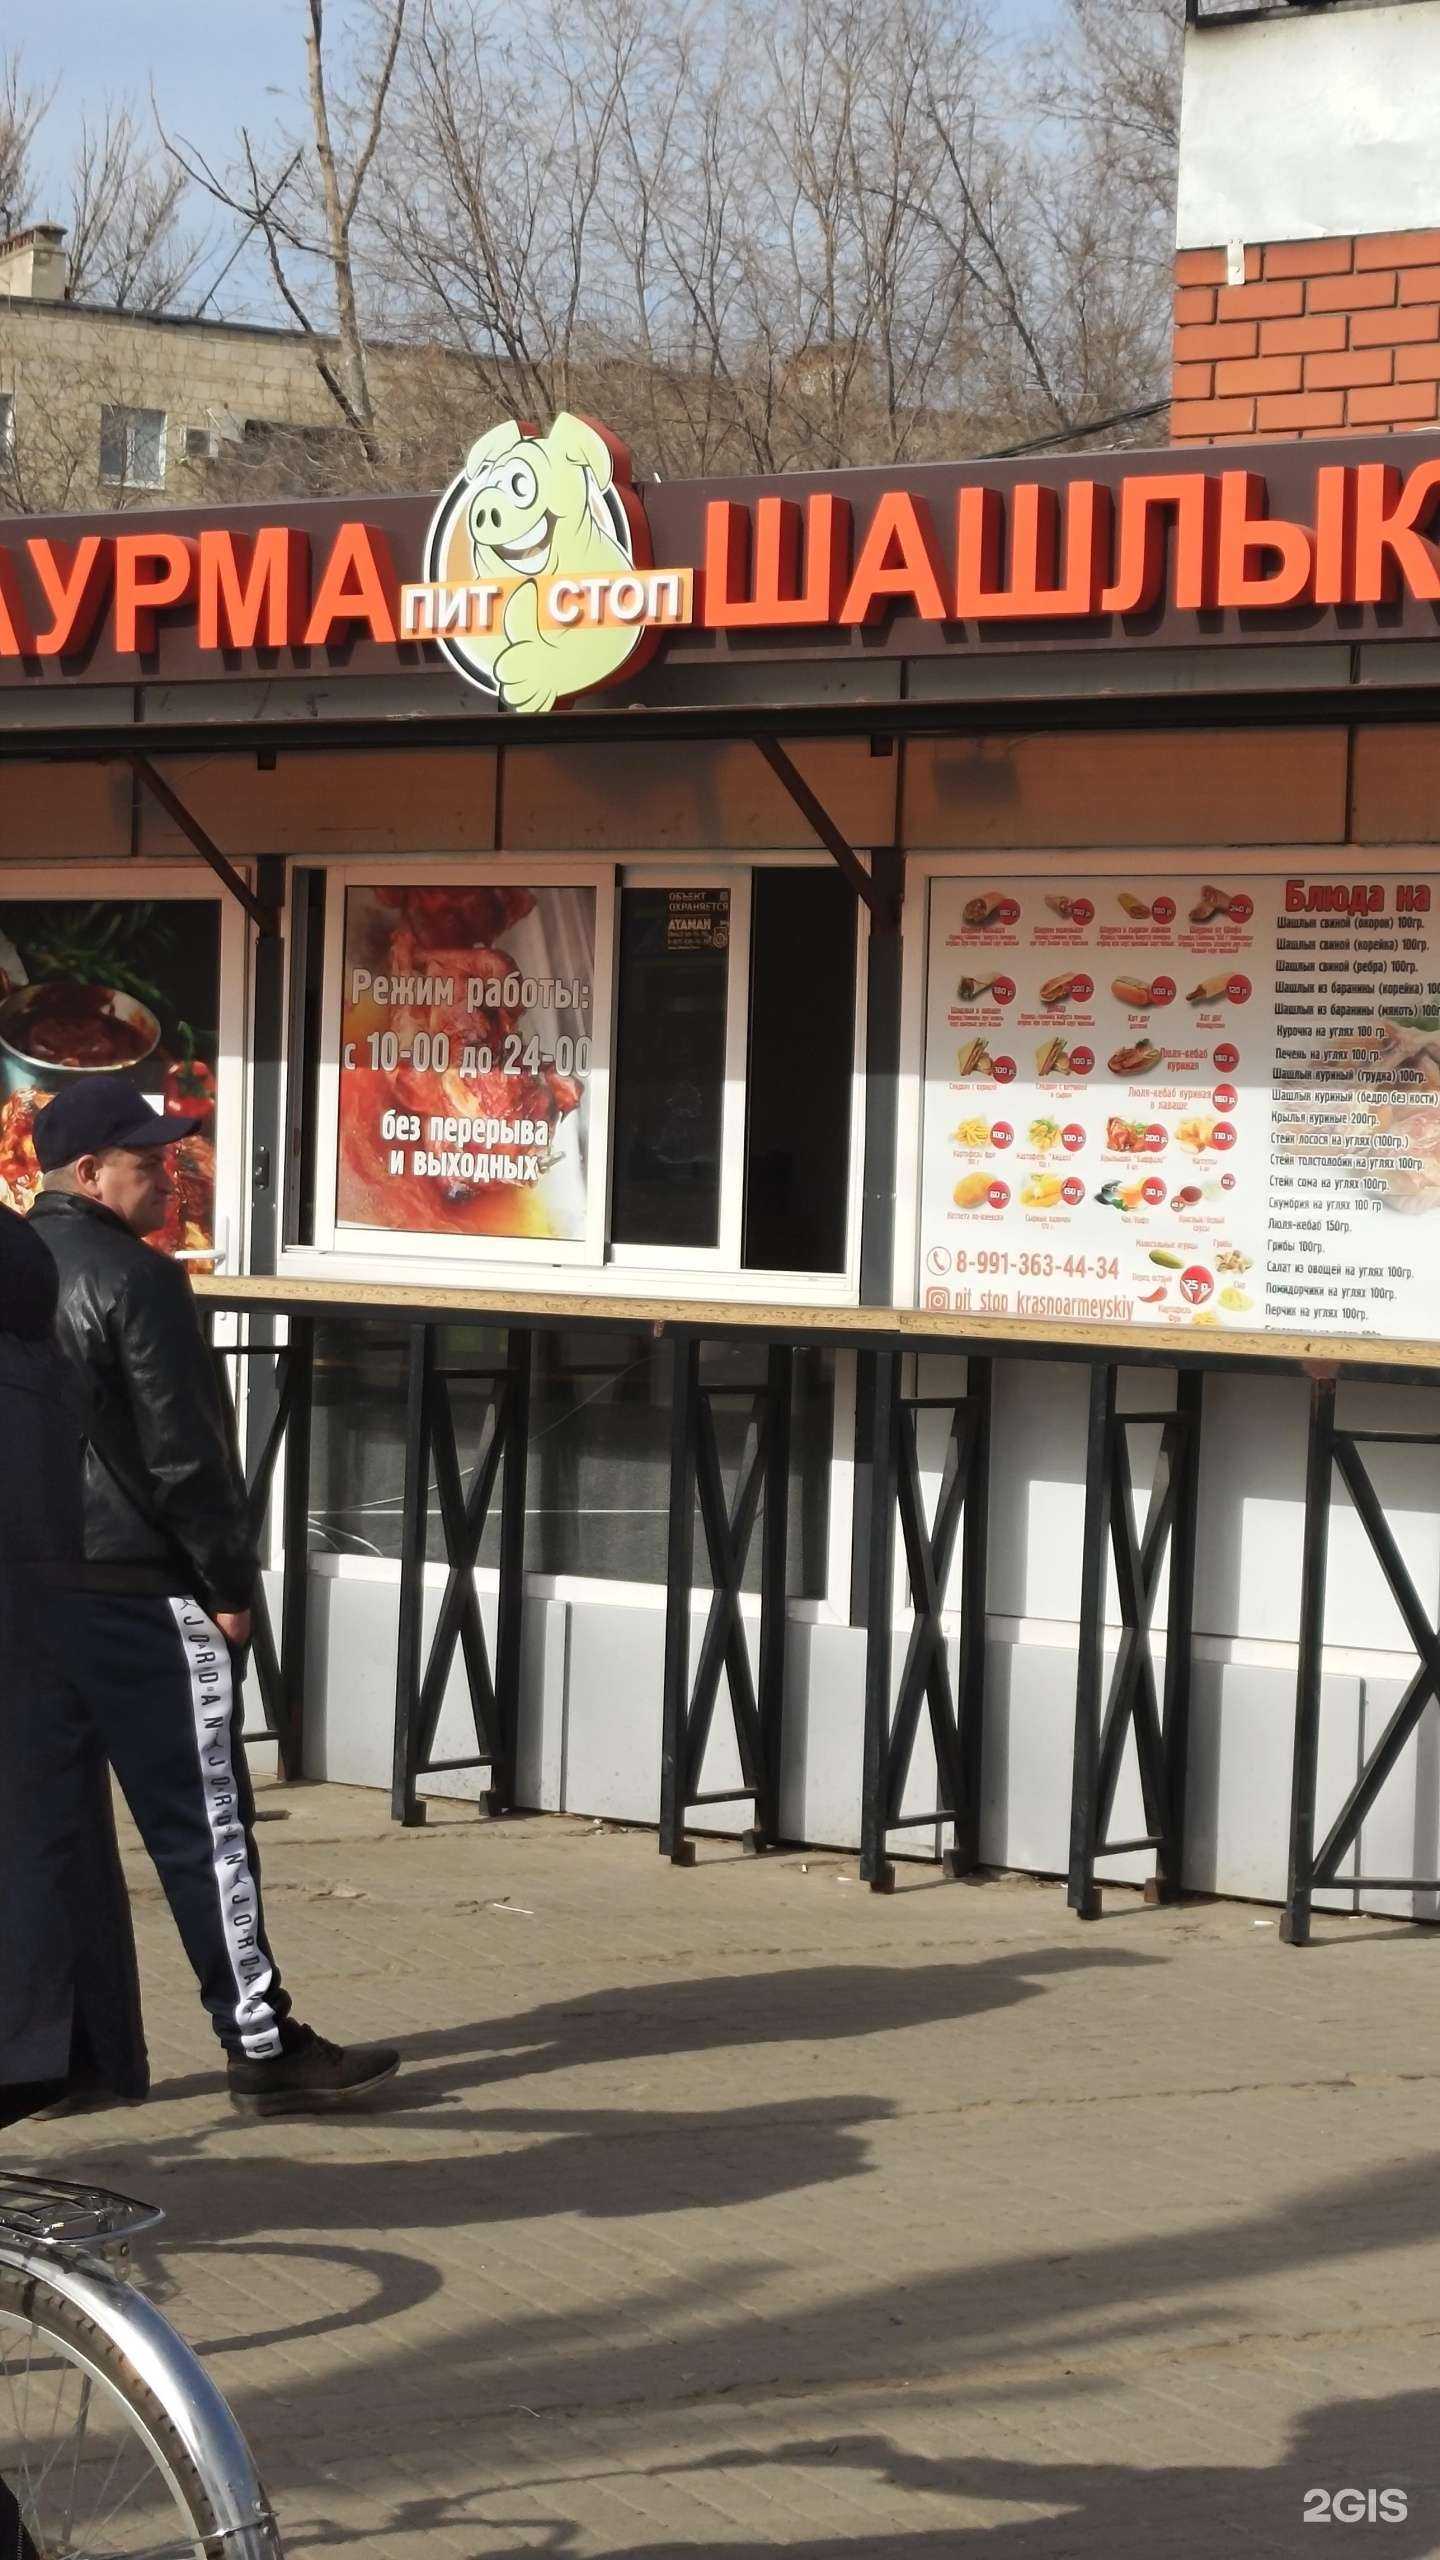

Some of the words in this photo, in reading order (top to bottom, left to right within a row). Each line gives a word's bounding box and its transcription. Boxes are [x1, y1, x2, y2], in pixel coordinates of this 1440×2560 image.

[705, 459, 1440, 628] ШАШЛЫК
[405, 586, 501, 632] ПИТ
[550, 575, 681, 624] СТОП
[1285, 880, 1385, 916] Блюда
[1396, 884, 1431, 912] на
[1277, 917, 1316, 928] Шашлык
[1276, 938, 1316, 950] Шашлык
[1276, 960, 1315, 972] Шашлык
[351, 969, 454, 1006] Режим
[467, 971, 590, 1013] работы:
[1275, 981, 1314, 993] Шашлык
[1275, 1003, 1313, 1015] Шашлык
[1277, 1025, 1312, 1040] Курочка
[1316, 1027, 1326, 1037] на
[1329, 1027, 1353, 1040] углях
[344, 1043, 356, 1070] с
[367, 1031, 450, 1073] 10-00
[459, 1046, 492, 1079] до
[503, 1034, 592, 1077] 24-00
[1276, 1048, 1306, 1060] Печень
[1310, 1051, 1320, 1060] на
[1324, 1050, 1348, 1063] углях
[1352, 1049, 1365, 1060] 100
[1273, 1068, 1312, 1080] Шашлык
[1357, 1070, 1395, 1083] (грудка)
[1400, 1070, 1426, 1083] 100гр.
[1272, 1089, 1311, 1101] Шашлык
[1357, 1092, 1387, 1104] (бедро
[1391, 1091, 1405, 1103] без
[1410, 1094, 1438, 1106] кости)
[1272, 1112, 1305, 1124] Крылья
[1309, 1114, 1347, 1127] куриные
[1351, 1113, 1379, 1127] 200гр.
[382, 1110, 420, 1141] без
[430, 1116, 549, 1149] перерыва
[1271, 1133, 1294, 1144] Стейк
[1298, 1135, 1329, 1144] лосося
[1332, 1135, 1341, 1145] на
[1345, 1136, 1369, 1147] углях
[1373, 1136, 1409, 1148] (100гр.)
[390, 1150, 404, 1175] и
[413, 1152, 538, 1182] выходных
[1270, 1154, 1294, 1165] Стейк
[1356, 1158, 1366, 1167] на
[1370, 1158, 1394, 1170] углях
[1269, 1175, 1293, 1187] Стейк
[1297, 1178, 1317, 1187] сома
[1321, 1178, 1331, 1188] на
[1334, 1179, 1359, 1191] углях
[1363, 1178, 1390, 1191] 100гр.
[1269, 1197, 1310, 1210] Скумбрия
[1313, 1199, 1323, 1209] на
[1326, 1200, 1350, 1212] углях
[1355, 1200, 1369, 1210] 100
[1268, 1218, 1321, 1231] Люля-кебаб
[1326, 1220, 1352, 1234] 150гр.
[1267, 1240, 1295, 1252] Грибы
[1299, 1241, 1325, 1253] 100гр.
[956, 1250, 1119, 1280] 8-991-363-44-34
[1267, 1261, 1291, 1273] Салат
[1295, 1264, 1304, 1273] из
[1308, 1264, 1341, 1275] овощей
[1345, 1266, 1355, 1276] на
[1359, 1266, 1383, 1278] углях
[1388, 1266, 1414, 1279] 100гр.
[1266, 1282, 1324, 1297] Помидорчики
[1328, 1286, 1338, 1297] на
[1342, 1287, 1366, 1299] углях
[1370, 1287, 1397, 1301] 100гр.
[1265, 1304, 1296, 1317] Перчик
[1300, 1306, 1310, 1317] на
[1313, 1308, 1338, 1319] углях
[1342, 1308, 1368, 1321] 100гр.
[184, 1615, 224, 1729] JORDAN
[208, 1756, 244, 1865] JORDAN
